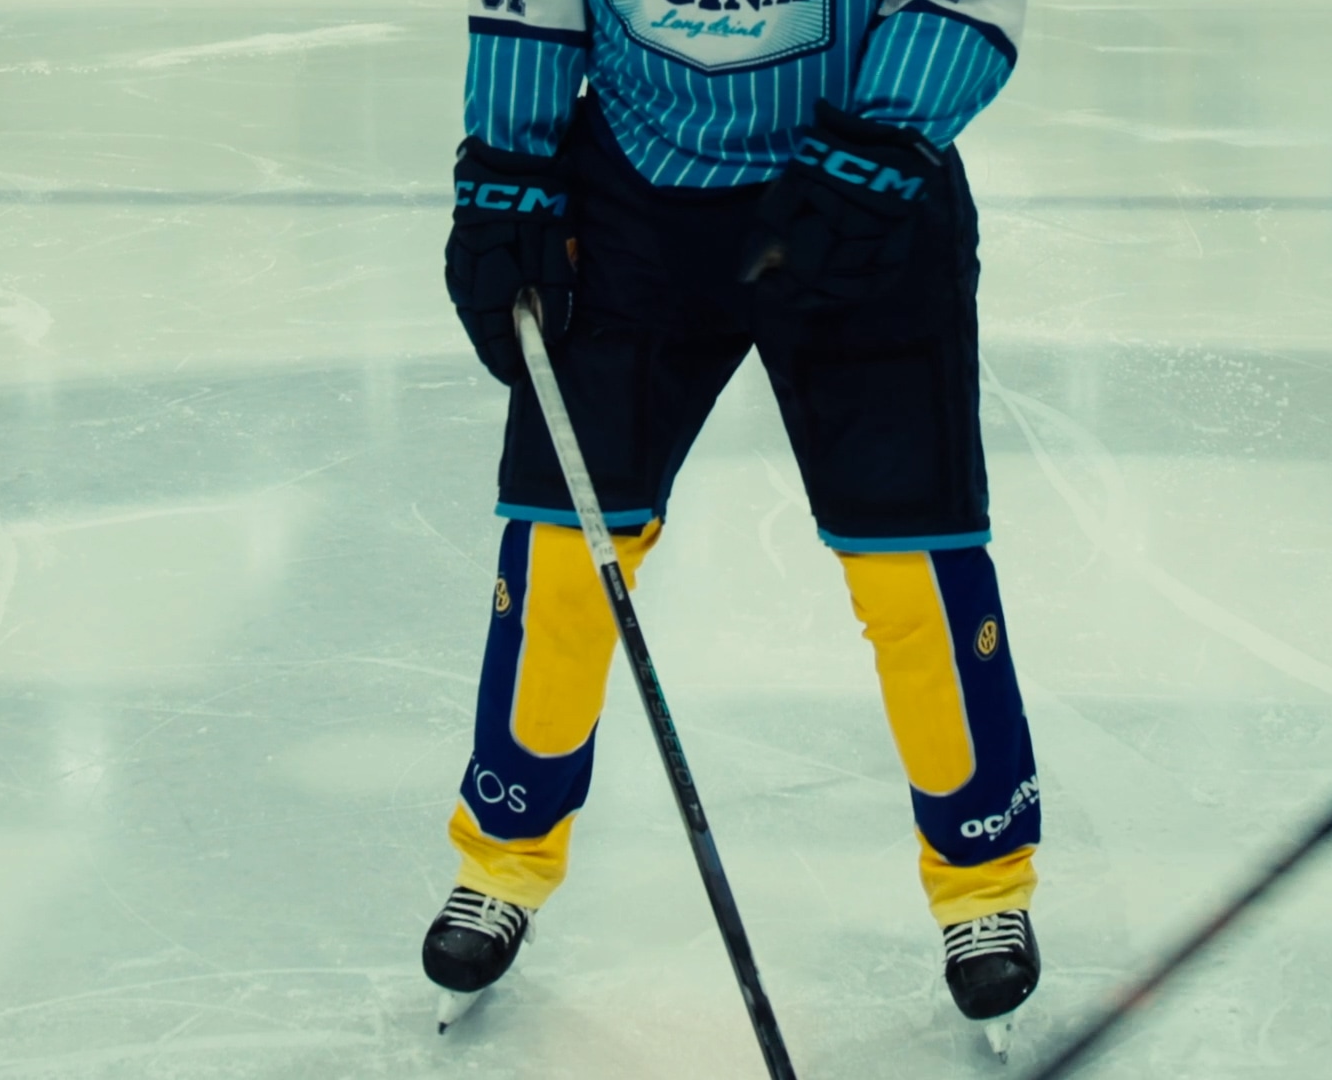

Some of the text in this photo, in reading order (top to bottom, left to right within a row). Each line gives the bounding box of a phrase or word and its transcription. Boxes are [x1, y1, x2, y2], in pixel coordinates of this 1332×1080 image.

[651, 9, 705, 38] Long
[793, 135, 926, 201] CCM
[455, 180, 569, 217] CCM
